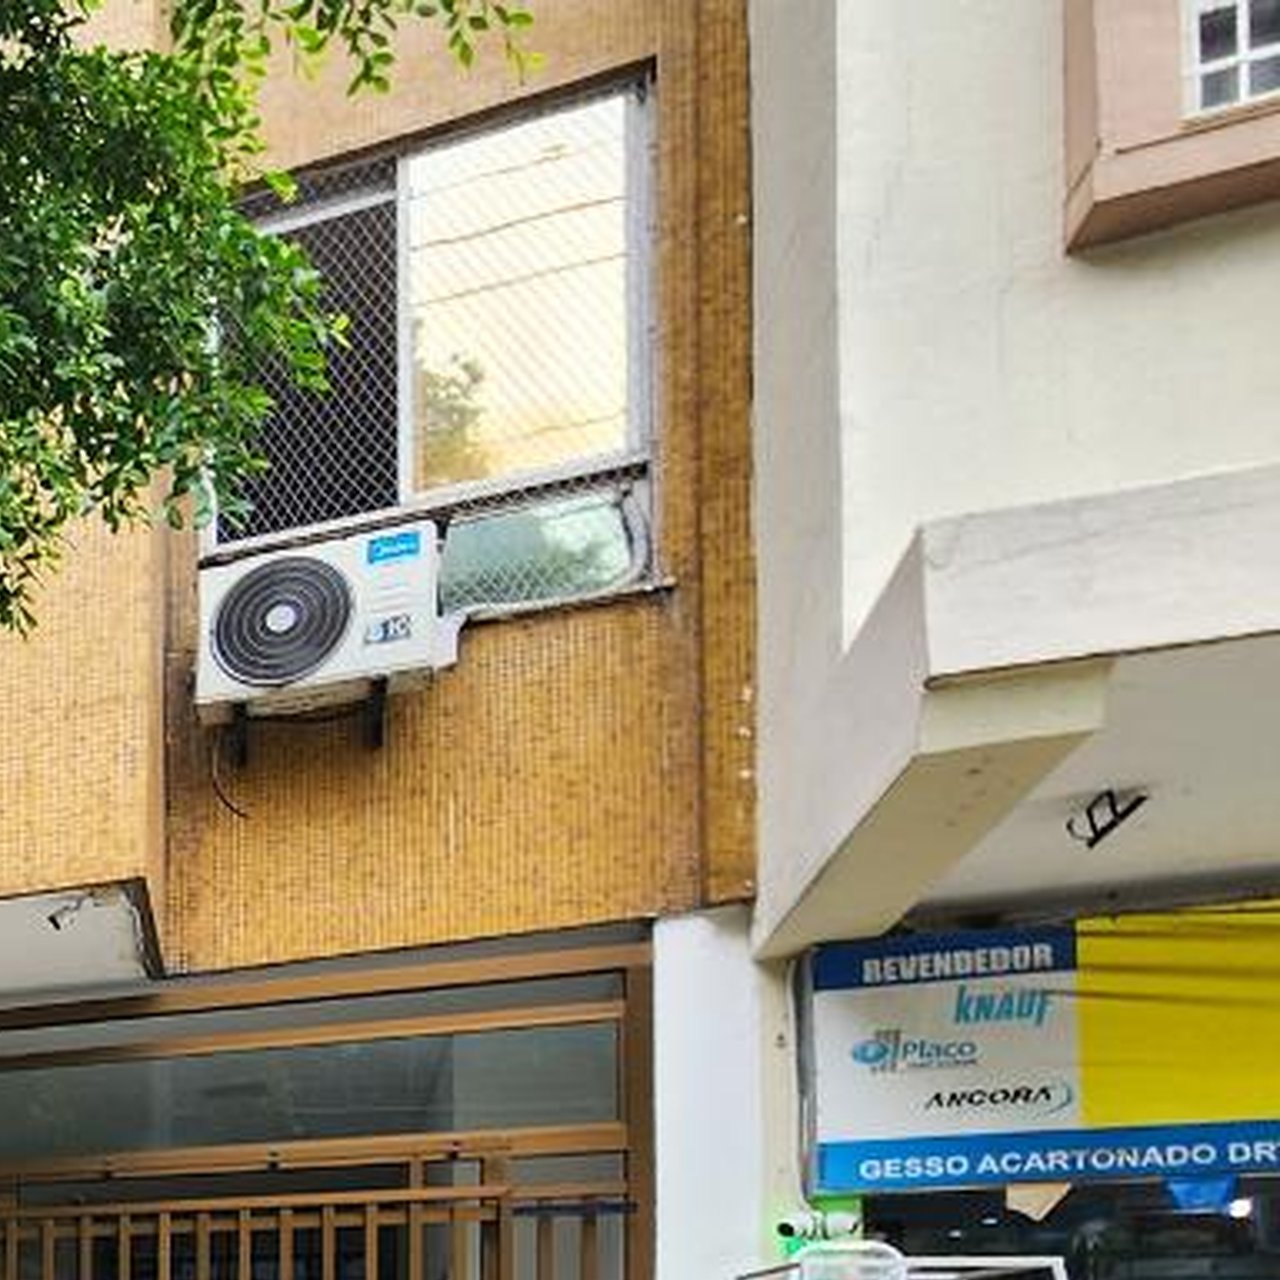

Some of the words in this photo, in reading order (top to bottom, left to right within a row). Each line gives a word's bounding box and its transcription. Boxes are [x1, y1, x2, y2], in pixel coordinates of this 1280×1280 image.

[863, 944, 1052, 983] REVENDEDOR
[903, 1039, 977, 1060] Placo
[924, 1085, 1053, 1110] ANCORA
[859, 1154, 969, 1180] GESSO
[976, 1142, 1217, 1175] ACARTONADO
[1228, 1141, 1280, 1164] DR
